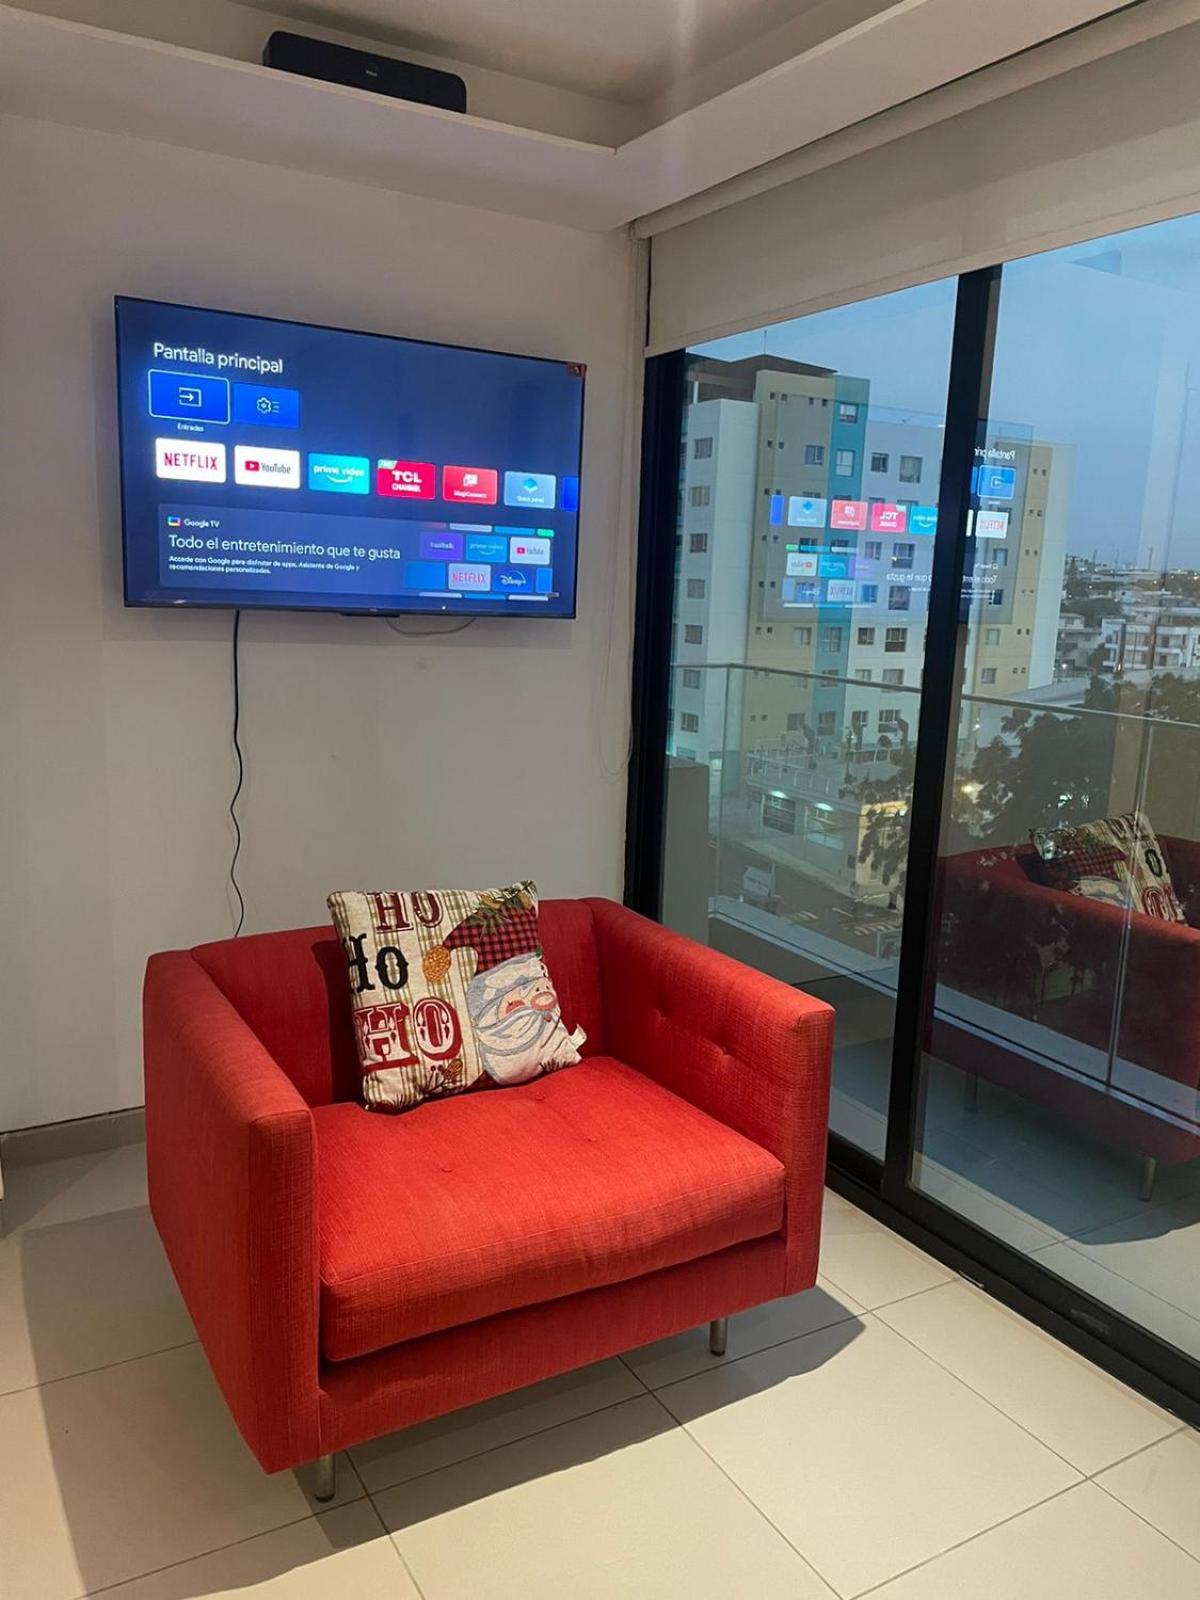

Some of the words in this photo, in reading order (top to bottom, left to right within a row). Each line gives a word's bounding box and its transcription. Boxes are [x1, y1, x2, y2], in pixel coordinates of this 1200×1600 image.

[153, 342, 215, 366] Pantalla
[217, 352, 283, 375] principal
[163, 452, 219, 471] NETFLIX
[261, 462, 292, 475] YouTube
[313, 465, 340, 475] prime
[342, 467, 366, 477] video
[391, 470, 423, 483] TCL
[391, 483, 422, 493] CHANNEL
[183, 518, 209, 529] Google
[210, 520, 220, 528] TV
[168, 534, 204, 549] Todo
[206, 537, 219, 550] el
[221, 539, 325, 556] entretenimiento
[327, 546, 351, 559] que
[353, 546, 366, 557] te
[367, 549, 401, 561] gusta
[169, 555, 194, 563] Accede
[207, 557, 231, 566] Google
[247, 559, 272, 567] disfrutar
[334, 563, 355, 572] Google
[452, 572, 487, 584] NETFLIX
[369, 890, 444, 932] HO
[355, 996, 463, 1072] HO
